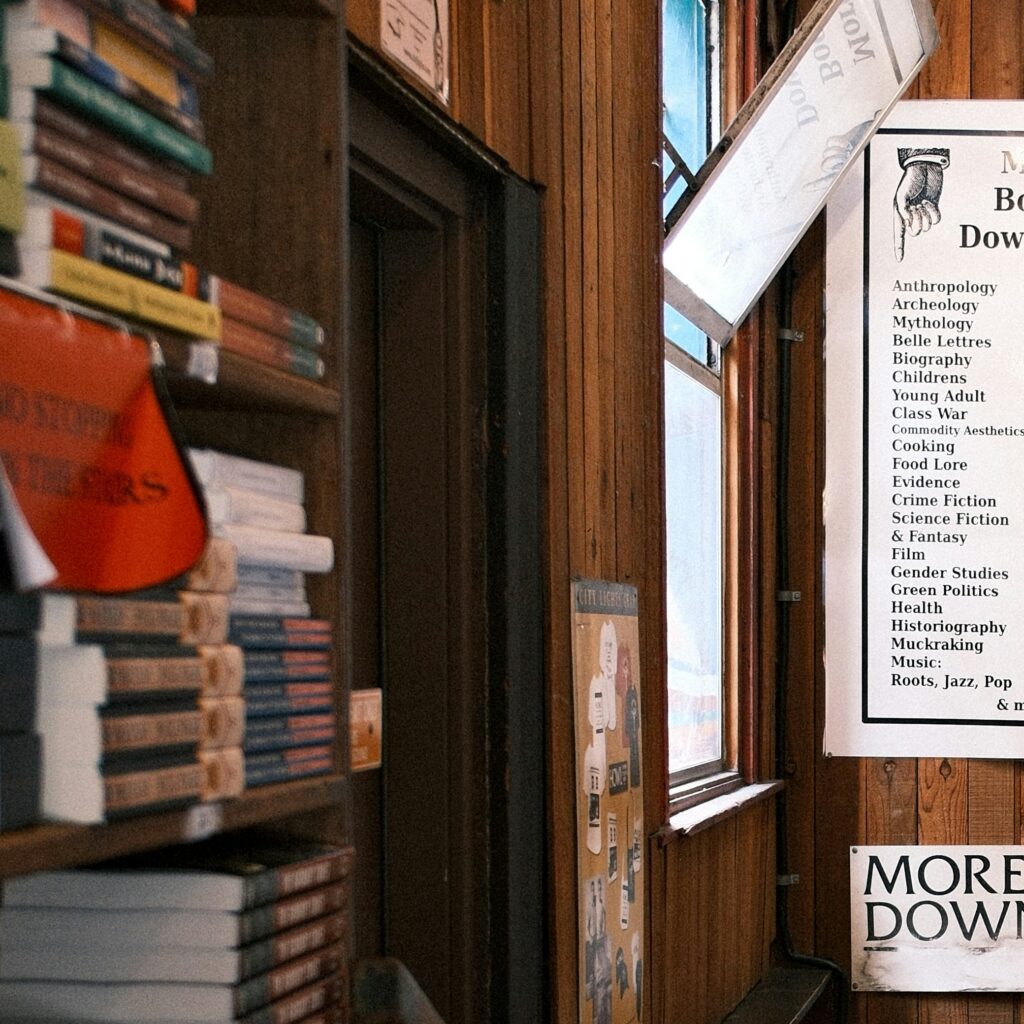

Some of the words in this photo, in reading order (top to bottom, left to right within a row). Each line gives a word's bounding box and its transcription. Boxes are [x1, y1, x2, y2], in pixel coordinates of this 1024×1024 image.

[892, 280, 998, 297] Anthropology
[892, 298, 979, 315] Archeology
[893, 316, 974, 333] Mythology
[893, 334, 931, 347] Belle
[937, 335, 991, 348] Lettres
[893, 352, 972, 369] Biography
[892, 370, 967, 384] Childrens
[892, 389, 939, 405] Young
[944, 389, 986, 402] Adult
[892, 406, 932, 419] Class
[937, 407, 968, 420] War
[892, 424, 960, 440] Commodity
[892, 439, 955, 456] Cooking
[892, 457, 928, 470] Food
[934, 458, 968, 471] Lore
[892, 475, 960, 489] Evidence
[892, 493, 938, 506] Crime
[944, 494, 997, 507] Fiction
[892, 511, 952, 526] Science
[956, 513, 1009, 526] Fiction
[891, 529, 904, 542] &
[909, 529, 968, 546] Fantasy
[891, 547, 926, 560] Film
[891, 565, 947, 578] Gender
[952, 567, 1009, 580] Studies
[891, 583, 937, 596] Green
[942, 584, 999, 597] Politics
[891, 601, 943, 614] Health
[891, 619, 1007, 637] Historiography
[891, 637, 984, 655] Muckraking
[891, 656, 942, 668] Music:
[891, 673, 938, 688] Roots,
[942, 674, 978, 690] Jazz,
[984, 675, 1012, 691] Pop
[997, 699, 1009, 711] &
